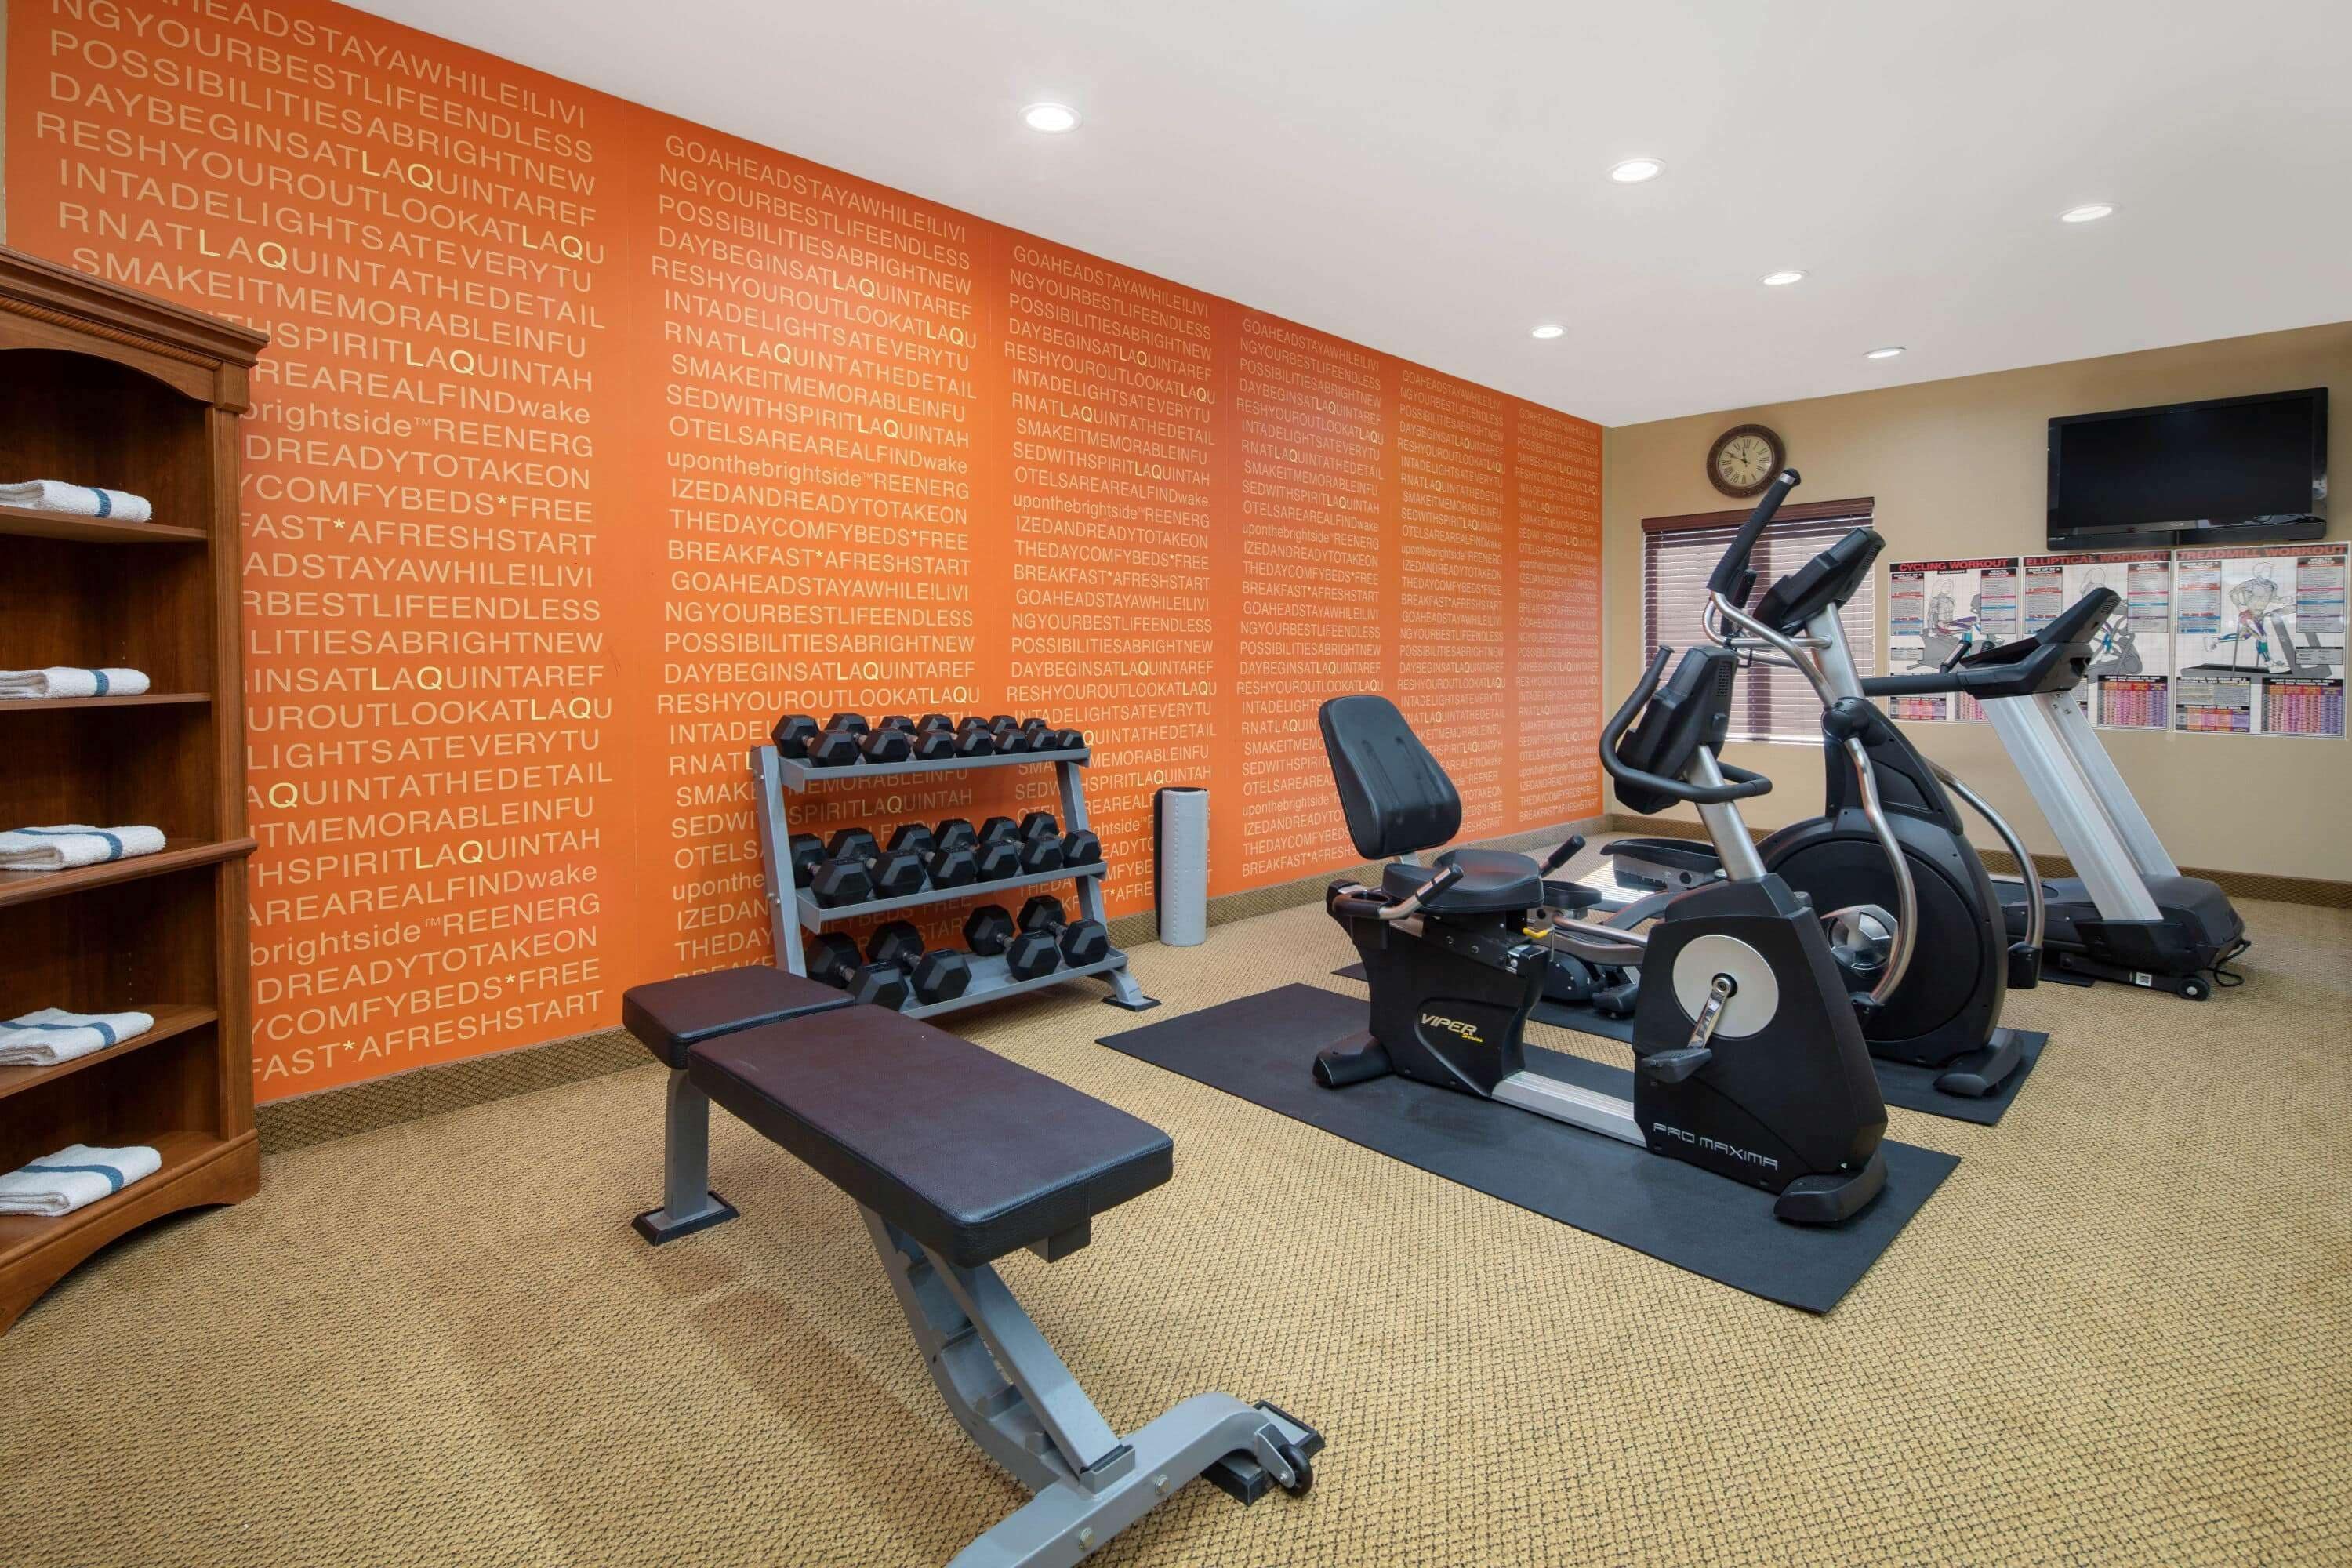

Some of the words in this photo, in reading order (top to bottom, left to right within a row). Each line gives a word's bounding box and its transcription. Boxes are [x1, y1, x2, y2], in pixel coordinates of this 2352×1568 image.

[50, 27, 594, 196] POSSIBILITIESABRIGHTNEW
[50, 70, 595, 228] DAYBEGINSATLAQUINTAREF
[35, 110, 604, 263] RESHYOUROUTLOOKATLAQU
[666, 136, 964, 243] GOAHEADSTAYAWHILE!LIVI
[60, 158, 590, 293] INTADELIGHTSATEVERYTU
[660, 165, 968, 270] NGYOURBESTLIFEENDLESS
[60, 201, 604, 328] RNATLAQUINTATHEDETAIL
[659, 197, 971, 296] POSSIBILITIESABRIGHTNEW
[659, 227, 971, 321] DAYBEGINSATLAQUINTAREF
[72, 246, 586, 358] SMAKEITMEMORABLEINFU
[652, 257, 975, 348] RESHYOUROUTLOOKATLAQU
[1010, 270, 1210, 339] NGYOURBESTLIFEENDLESS
[1014, 247, 1207, 318] GOAHEADSTAYAWHILE!LIVI
[666, 291, 967, 372] INTADELIGHTSATEVERYTU
[1010, 294, 1210, 361] POSSIBILITIESABRIGHTNEW
[1010, 319, 1210, 381] DAYBEGINSATLAQUINTAREF
[665, 322, 976, 399] RNATLAQUINTATHEDETAIL
[1005, 342, 1214, 403] RESHYOUROUTLOOKATLAQU
[667, 384, 968, 448] SEDWITHSPIRITLAQUINTAH
[672, 354, 964, 423] SMAKEITMEMORABLEINFU
[1013, 368, 1209, 423] INTADELIGHTSATEVERYTU
[670, 416, 966, 474] OTELSAREAREALFINDwake
[1012, 393, 1214, 445] RNATLAQUINTATHEDETAIL
[1017, 418, 1206, 464] SMAKEITMEMORABLEINFU
[247, 434, 589, 490] DREADYTOTAKEON
[1013, 441, 1209, 485] SEDWITHSPIRITLAQUINTAH
[1015, 466, 1207, 506] OTELSAREAREALFINDwake
[673, 477, 966, 525] IZEDANDREADYTOTAKEON
[1017, 515, 1207, 548] IZEDANDREADYTOTAKEON
[2181, 550, 2260, 560] TREADMILL
[2265, 546, 2344, 557] WORKOUT
[672, 570, 967, 602] GOAHEADSTAYAWHILE!LIVI
[1899, 562, 1946, 572] CYCLING
[1949, 559, 2008, 569] WORKOUT
[2025, 557, 2095, 566] ELLIPTICAL
[2100, 554, 2169, 563] WORKOUT
[666, 601, 971, 627] NGYOURBESTLIFEENDLESS
[1012, 612, 1211, 633] NGYOURBESTLIFEENDLESS
[1016, 588, 1208, 612] GOAHEADSTAYAWHILE!LIVI
[252, 631, 602, 658] LITIESABRIGHTNEW
[665, 632, 974, 653] POSSIBILITIESABRIGHTNEW
[1012, 637, 1213, 654] POSSIBILITIESABRIGHTNEW
[1012, 660, 1213, 678] DAYBEGINSATLAQUINTAREF
[665, 661, 974, 684] DAYBEGINSATLAQUINTAREF
[1007, 681, 1215, 702] RESHYOUROUTLOOKATLAQU
[249, 696, 612, 737] UROUTLOOKATLAQU
[658, 686, 978, 716] RESHYOUROUTLOOKATLAQU
[257, 926, 596, 1011] DREADYTOTAKEON
[1421, 1013, 1478, 1036] VIPER
[1653, 1122, 1695, 1144] PRO
[1699, 1137, 1778, 1171] MAXIMA
